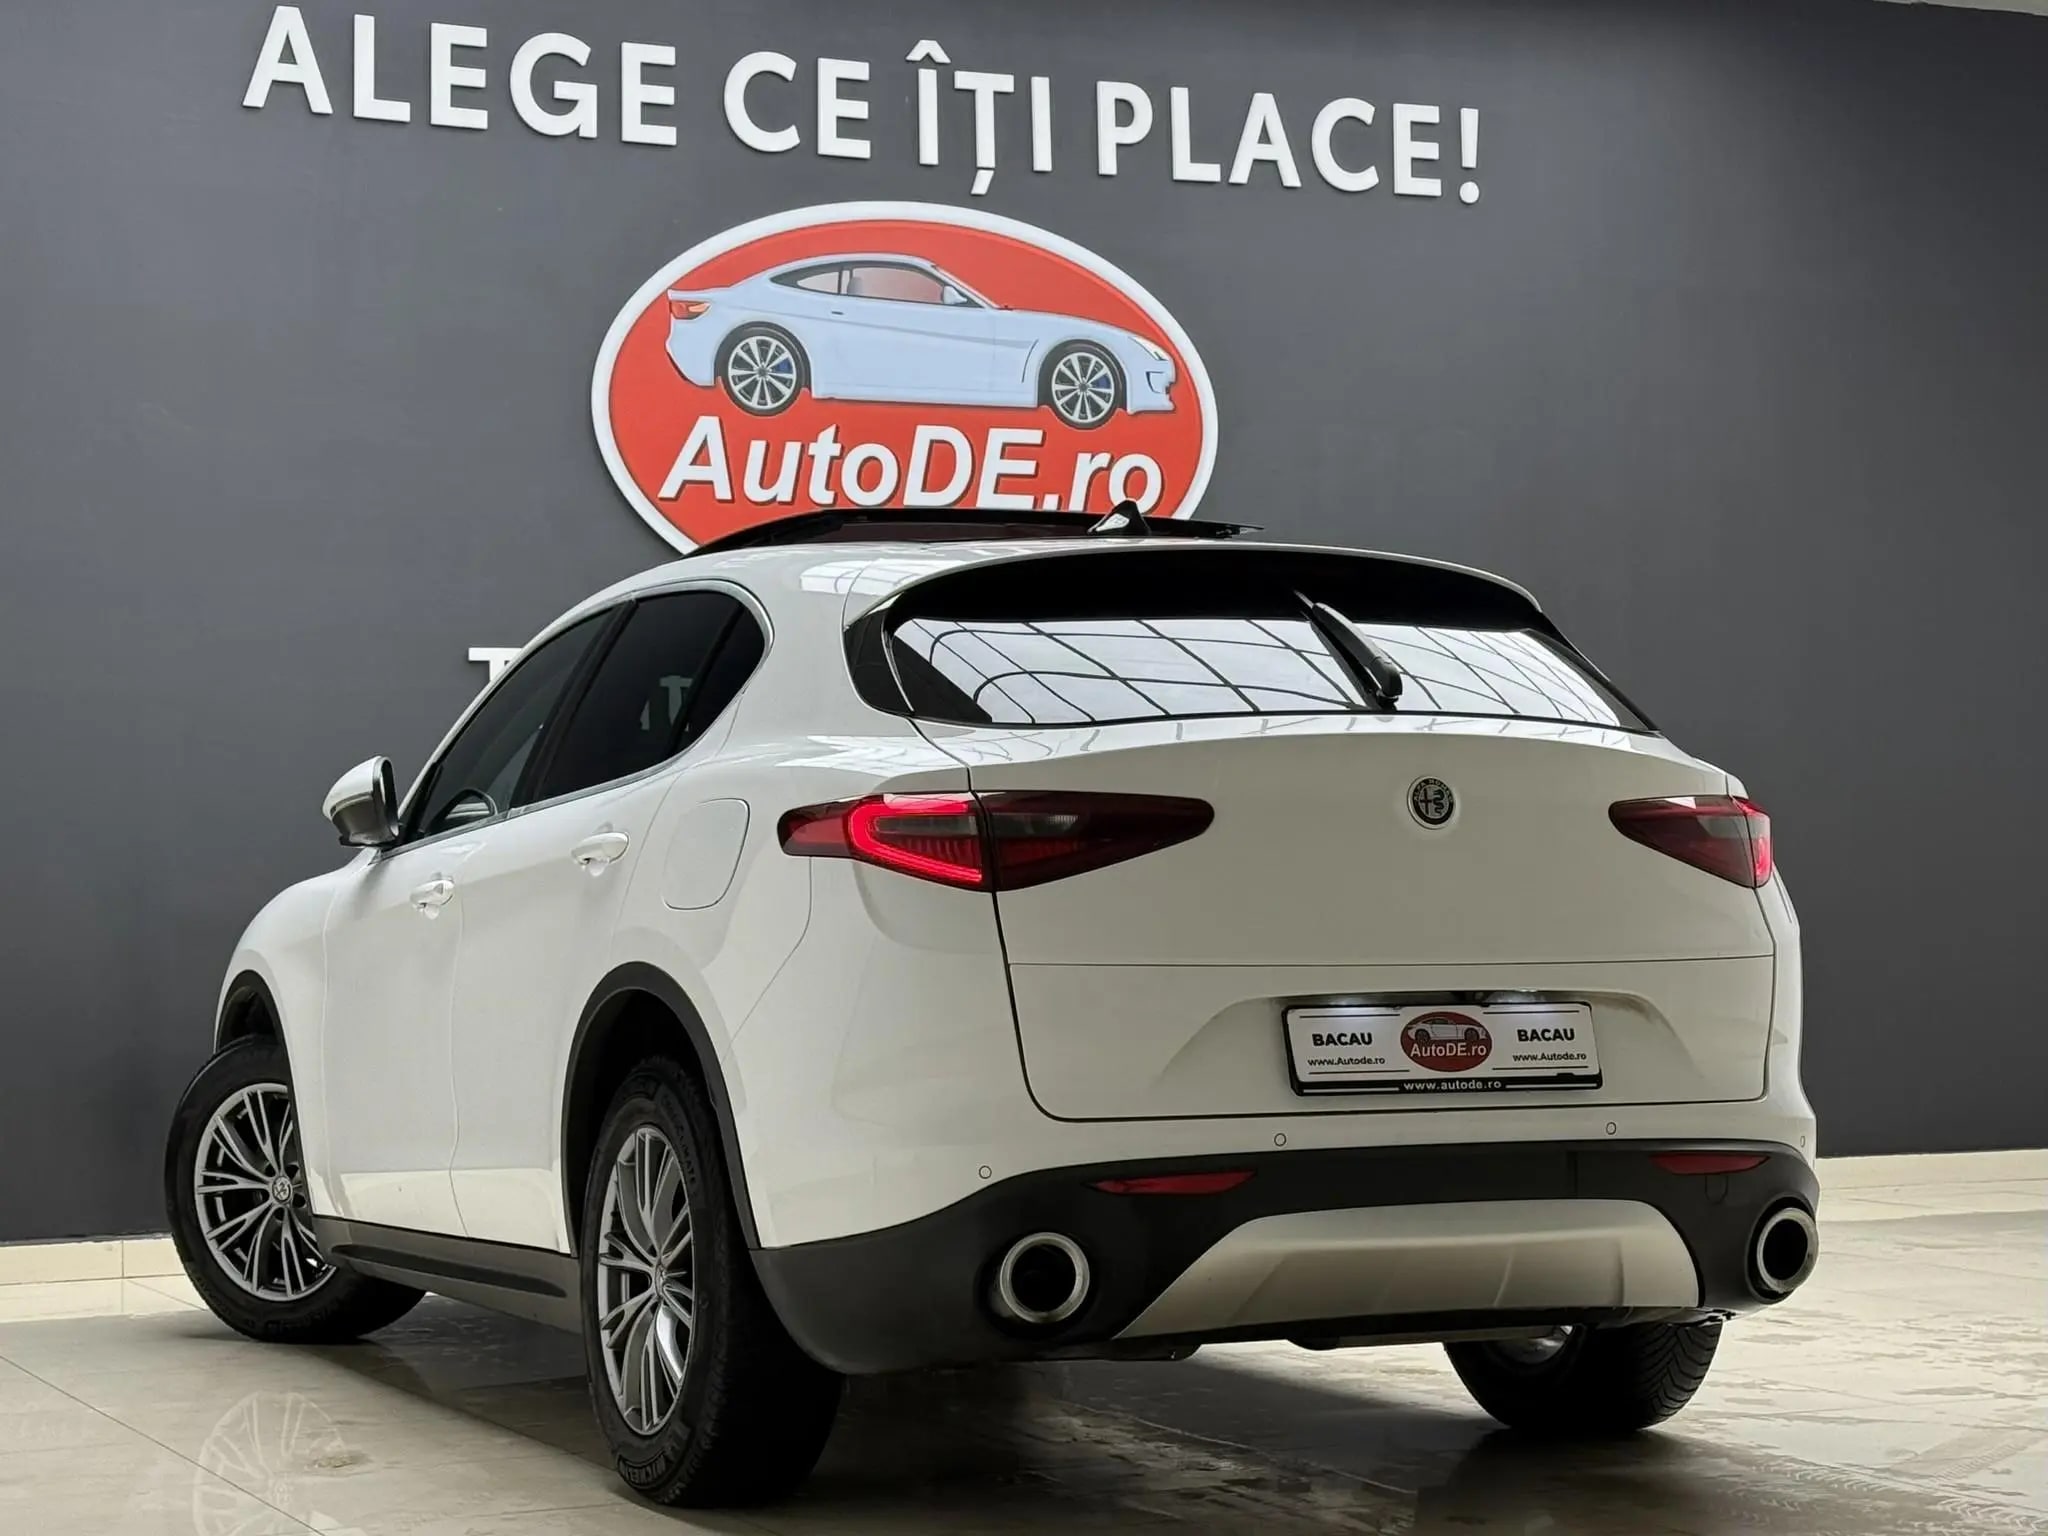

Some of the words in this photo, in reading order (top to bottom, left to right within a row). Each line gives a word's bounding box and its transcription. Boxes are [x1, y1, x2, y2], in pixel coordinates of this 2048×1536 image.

[242, 5, 677, 146] ALEGE
[723, 51, 871, 160] CE
[1096, 80, 1480, 204] PLACE!
[657, 415, 1163, 511] AutoDE.ro
[1312, 1032, 1373, 1047] BACAU
[1516, 1028, 1575, 1043] BACAU
[1410, 1041, 1488, 1060] AutoDE.ro
[1512, 1051, 1588, 1063] www.Autode.ro
[1307, 1056, 1386, 1067] www.Autode.ro
[1403, 1079, 1502, 1092] www.autode.ro
